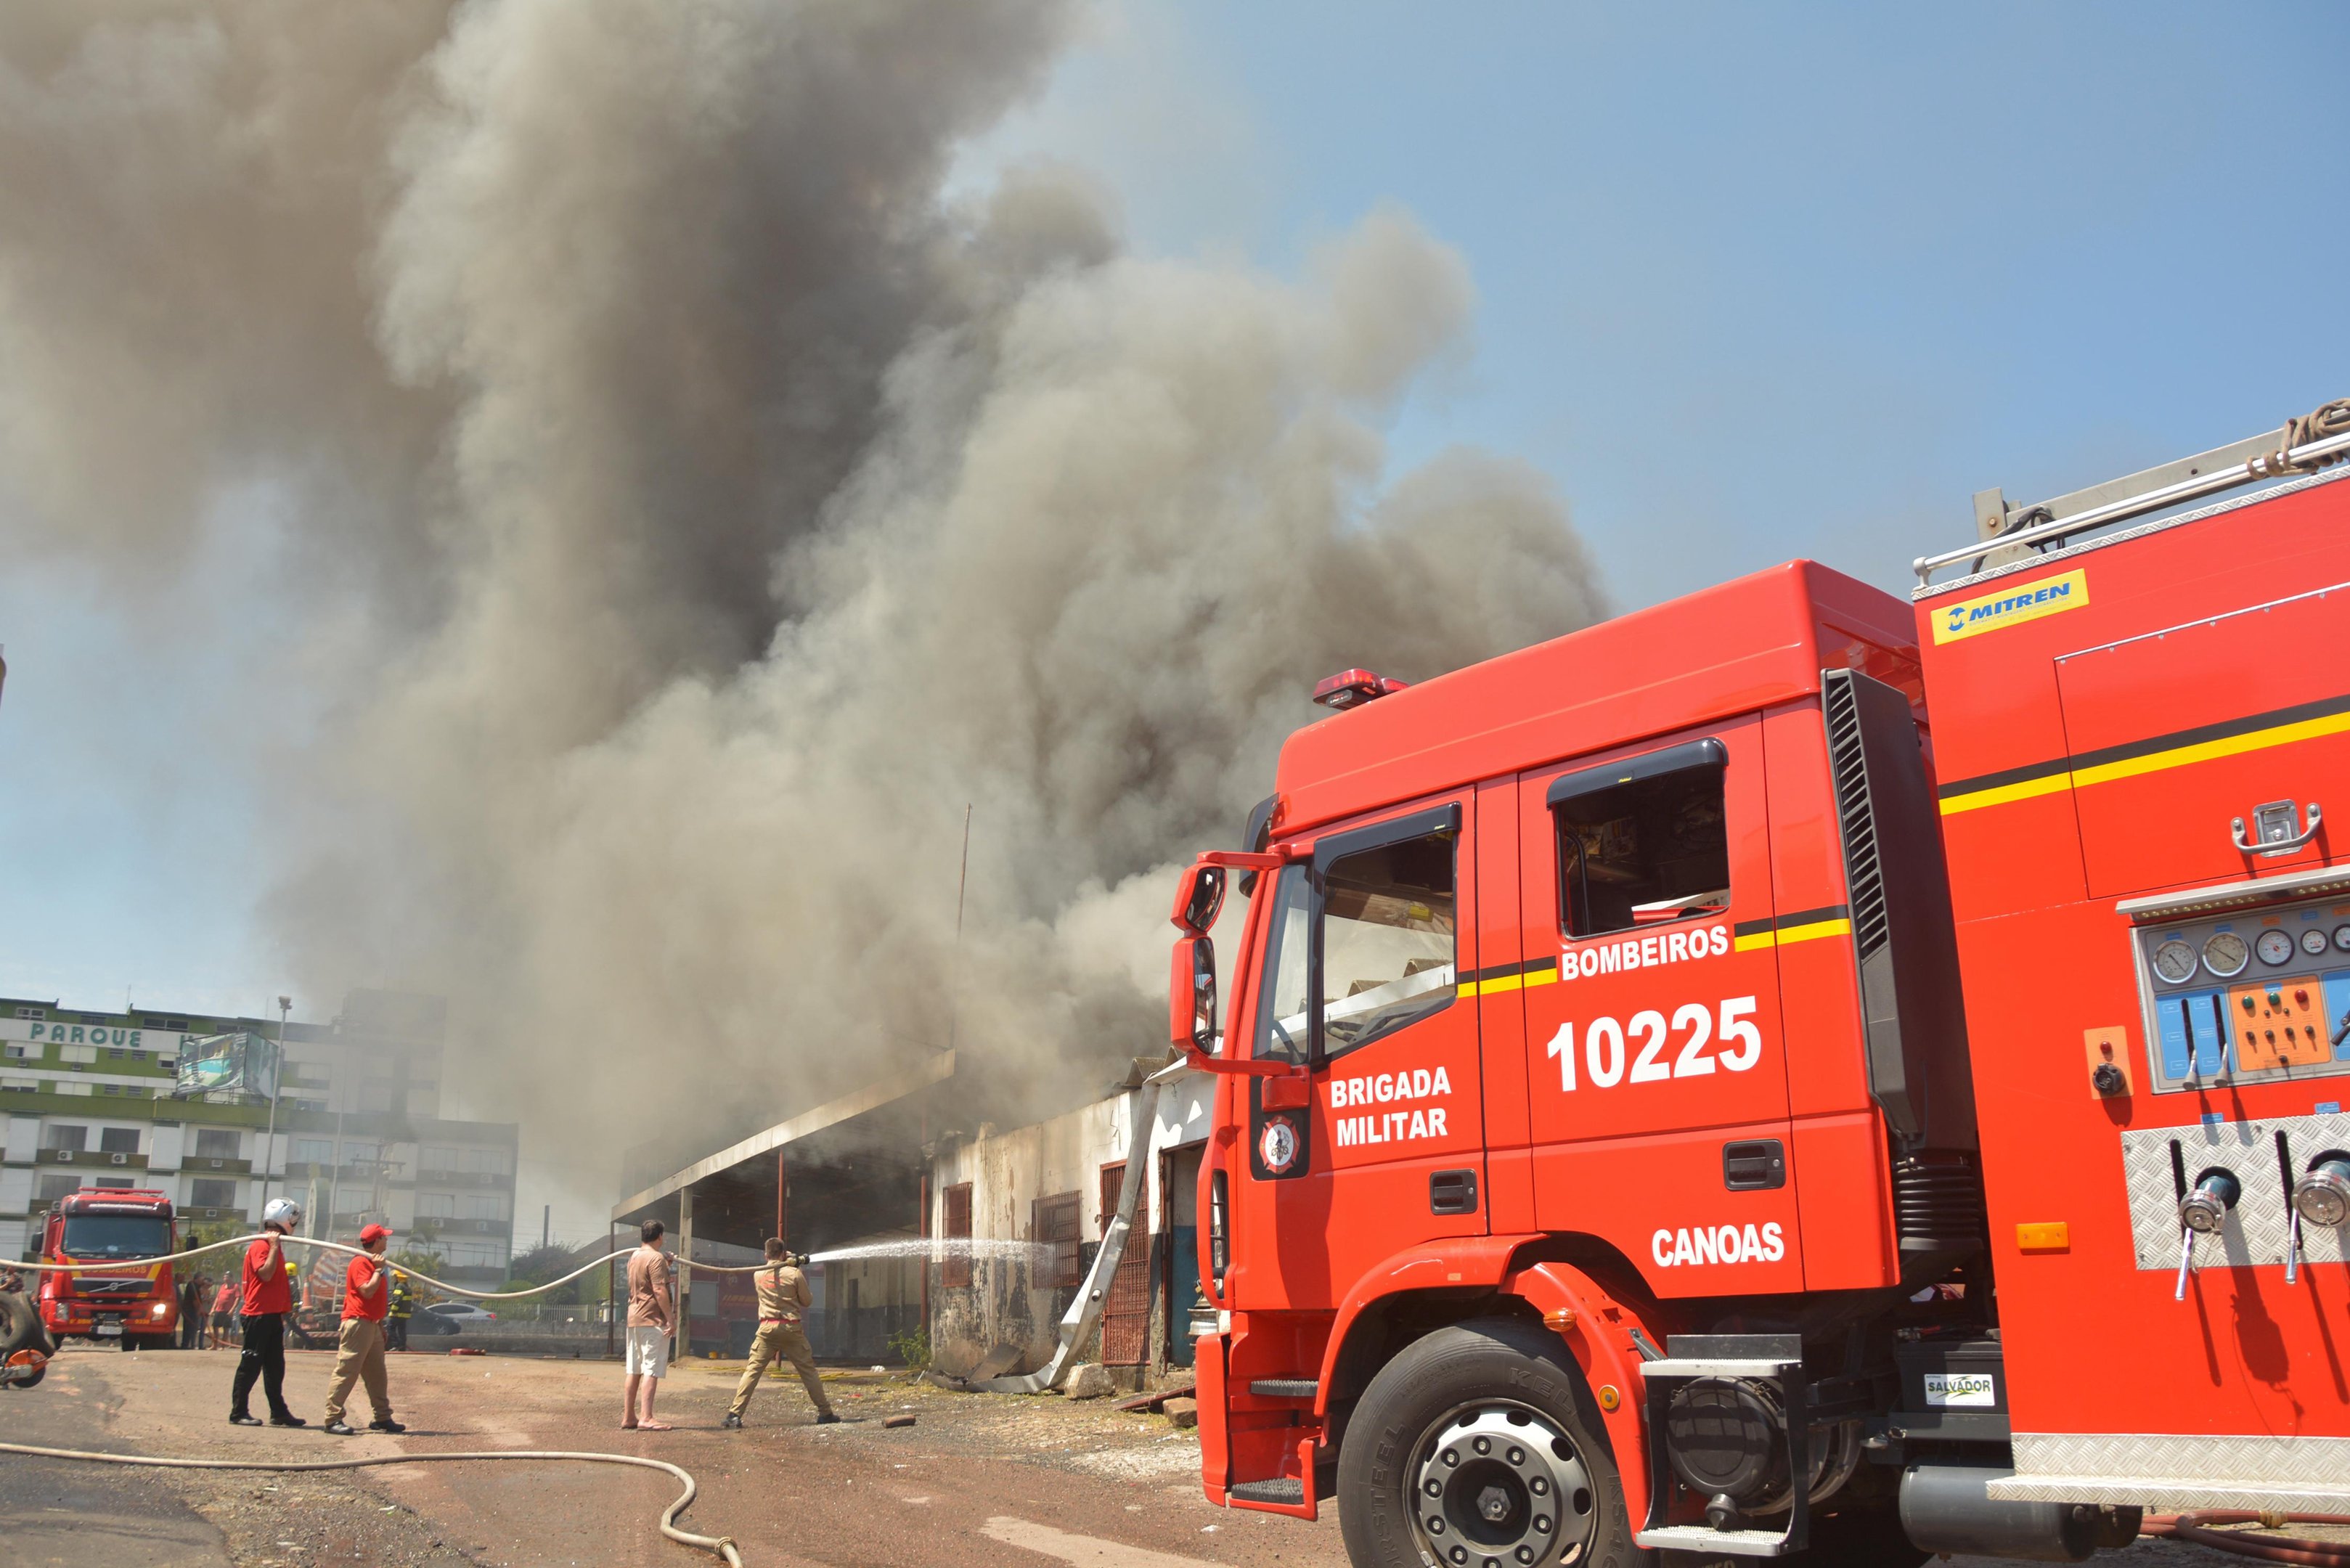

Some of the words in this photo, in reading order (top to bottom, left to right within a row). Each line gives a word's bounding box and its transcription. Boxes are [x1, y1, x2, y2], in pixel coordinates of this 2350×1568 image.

[1969, 582, 2070, 621] MITREN
[1562, 926, 1729, 981] BOMBEIROS
[30, 1023, 142, 1048] PARQUE
[1547, 995, 1761, 1092] 10225
[1331, 1066, 1451, 1108] BRIGADA
[1337, 1108, 1448, 1146] MILITAR
[1652, 1222, 1784, 1267] CANOAS
[1509, 1367, 1578, 1420] KEL
[1927, 1380, 1991, 1392] SALVADOR
